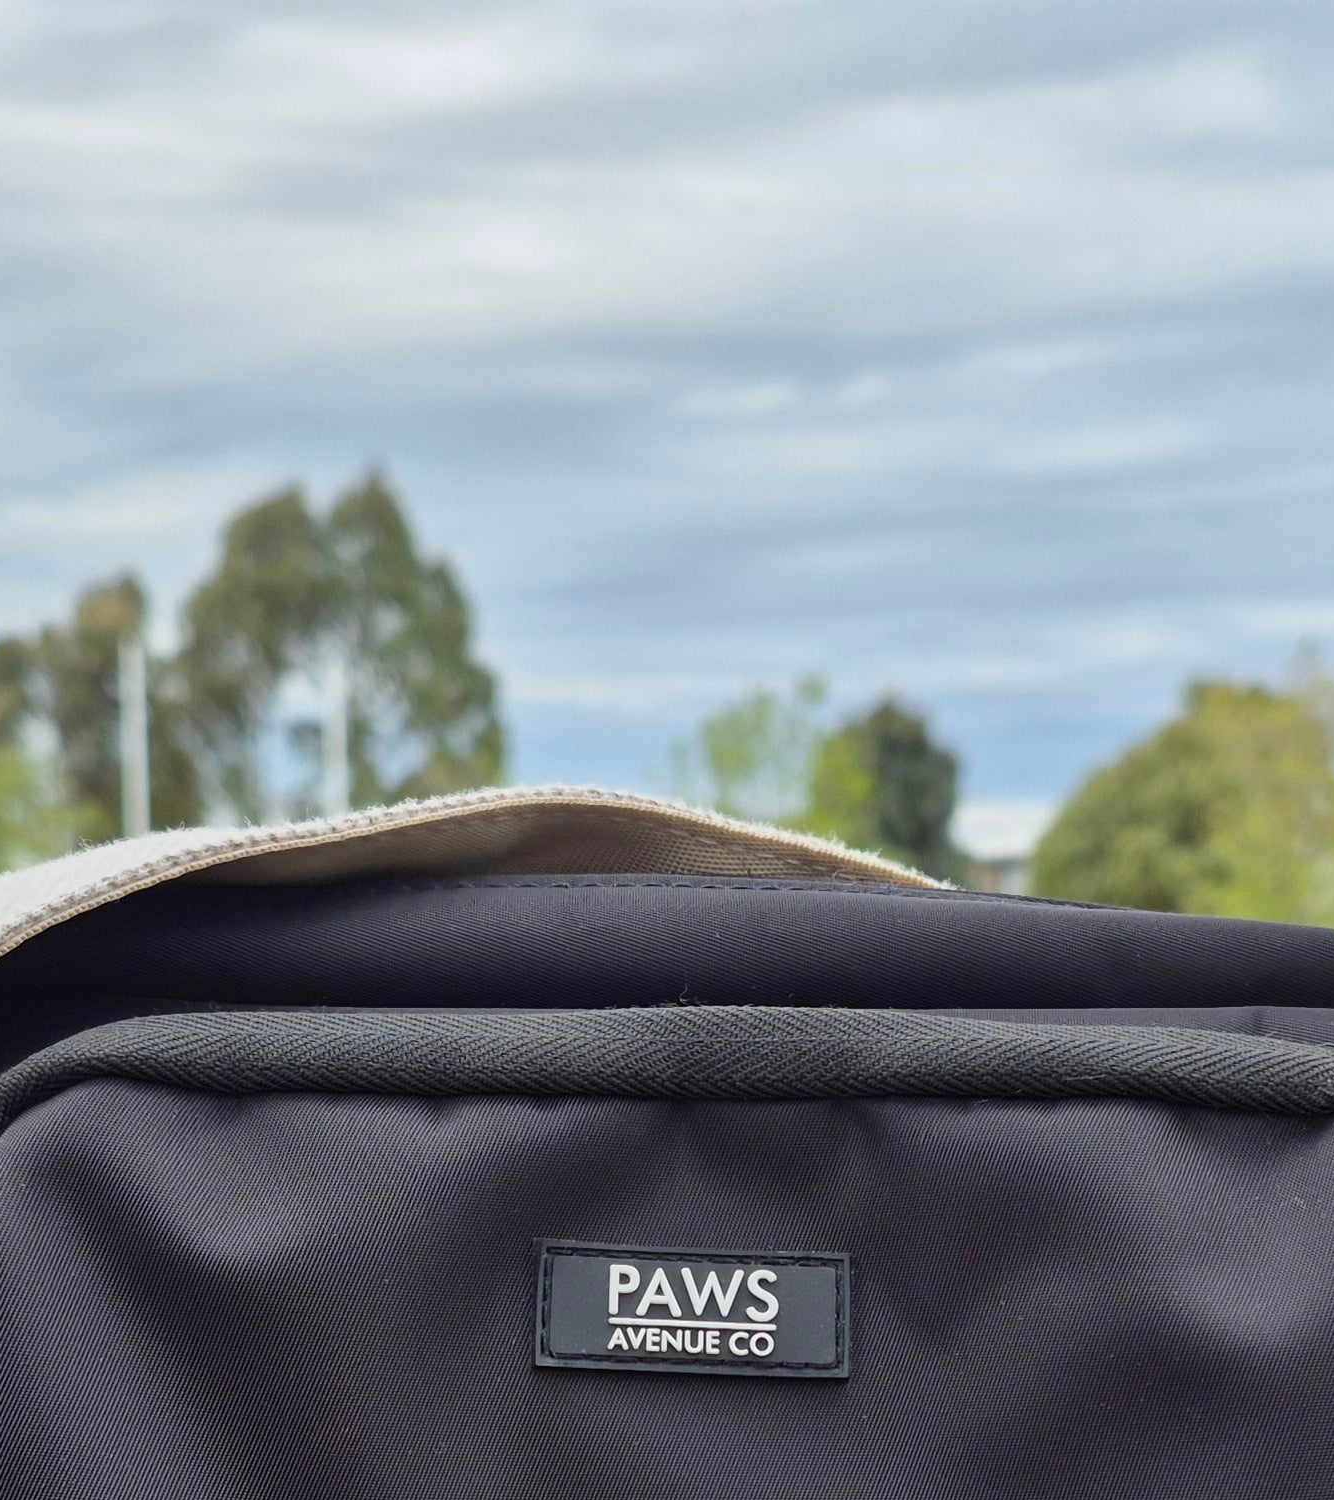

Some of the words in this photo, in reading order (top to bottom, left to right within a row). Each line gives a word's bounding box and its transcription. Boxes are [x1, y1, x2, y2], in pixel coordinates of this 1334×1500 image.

[608, 1264, 779, 1322] PAWS
[607, 1327, 721, 1355] AVENUE
[728, 1331, 775, 1357] CO
